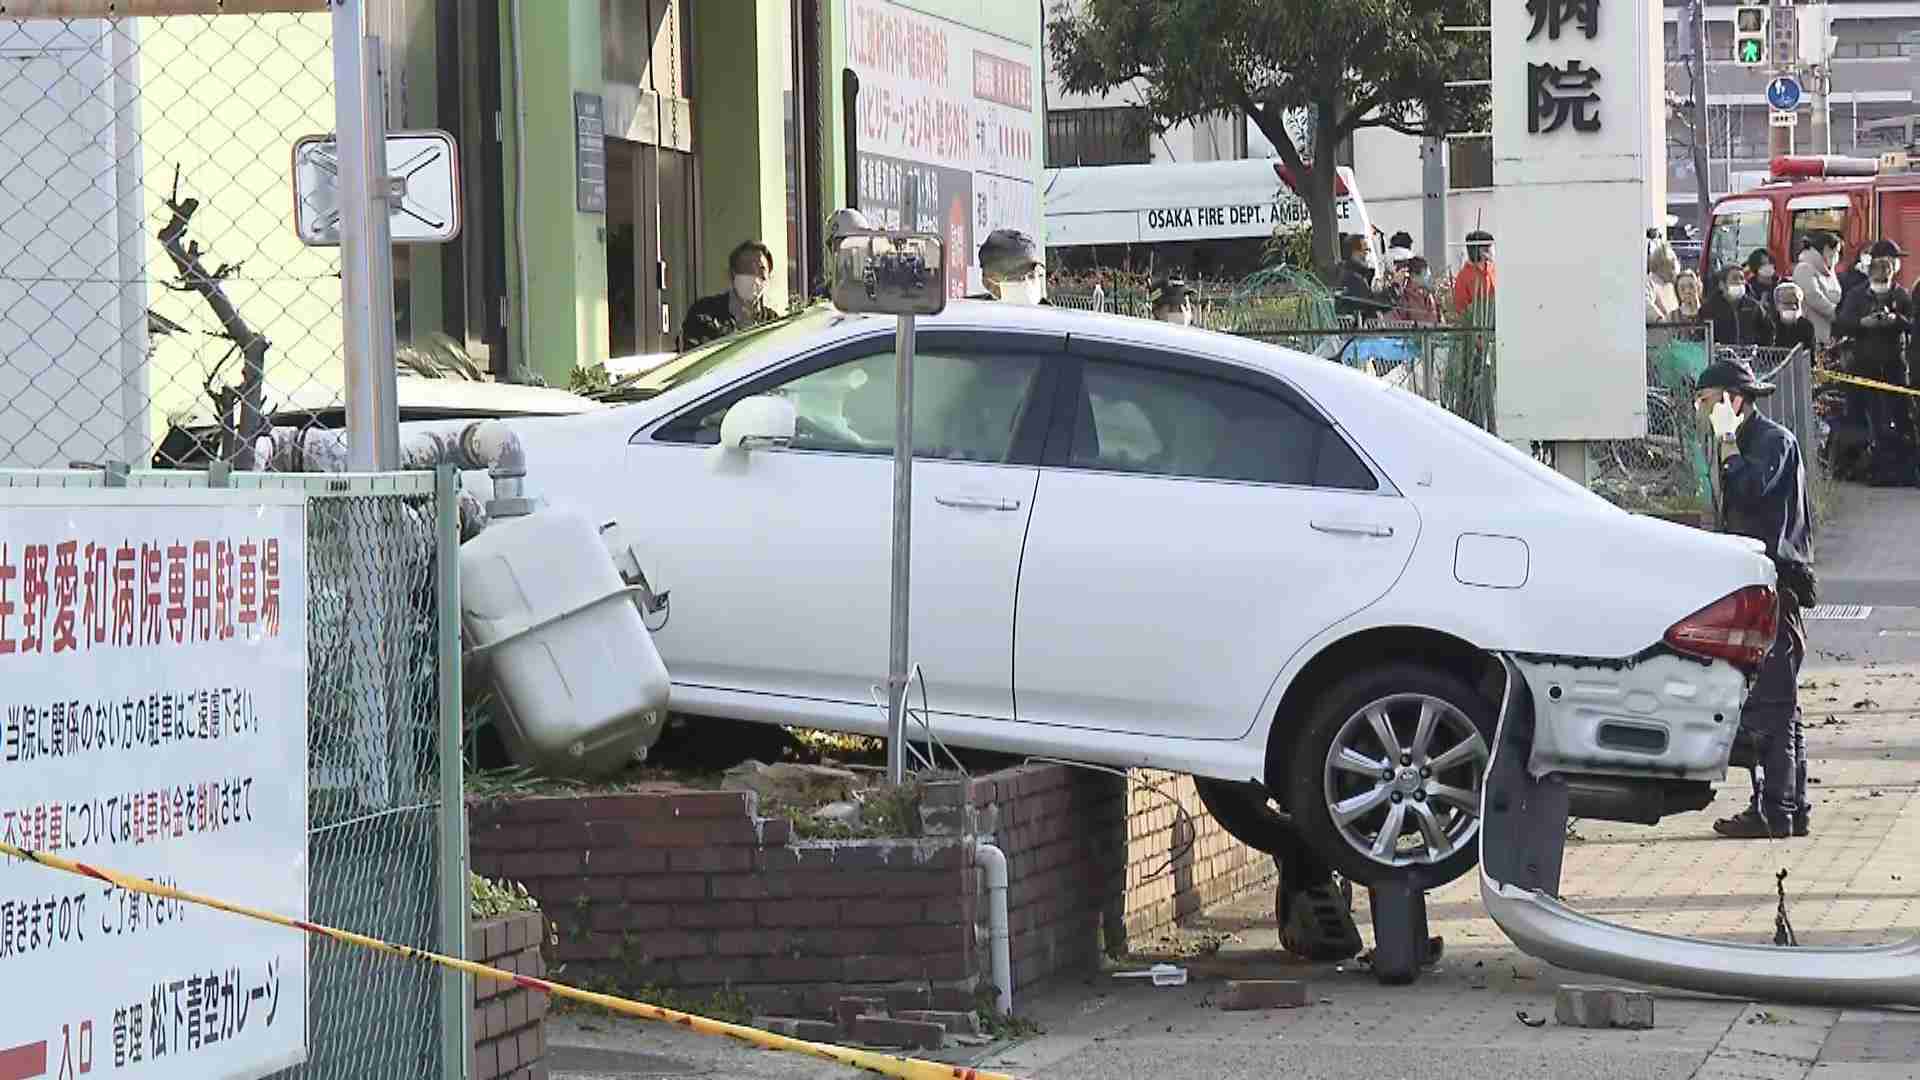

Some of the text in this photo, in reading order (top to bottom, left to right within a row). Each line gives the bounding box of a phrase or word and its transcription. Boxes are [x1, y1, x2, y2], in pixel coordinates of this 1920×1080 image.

[1526, 0, 1601, 133] 病院
[1148, 202, 1349, 228] OSAKA FIRE DEPT. AMBUCE
[0, 893, 85, 958] 頂きますので
[112, 956, 280, 1067] 管理 松下青空ガレージ
[58, 1020, 93, 1080] 入口
